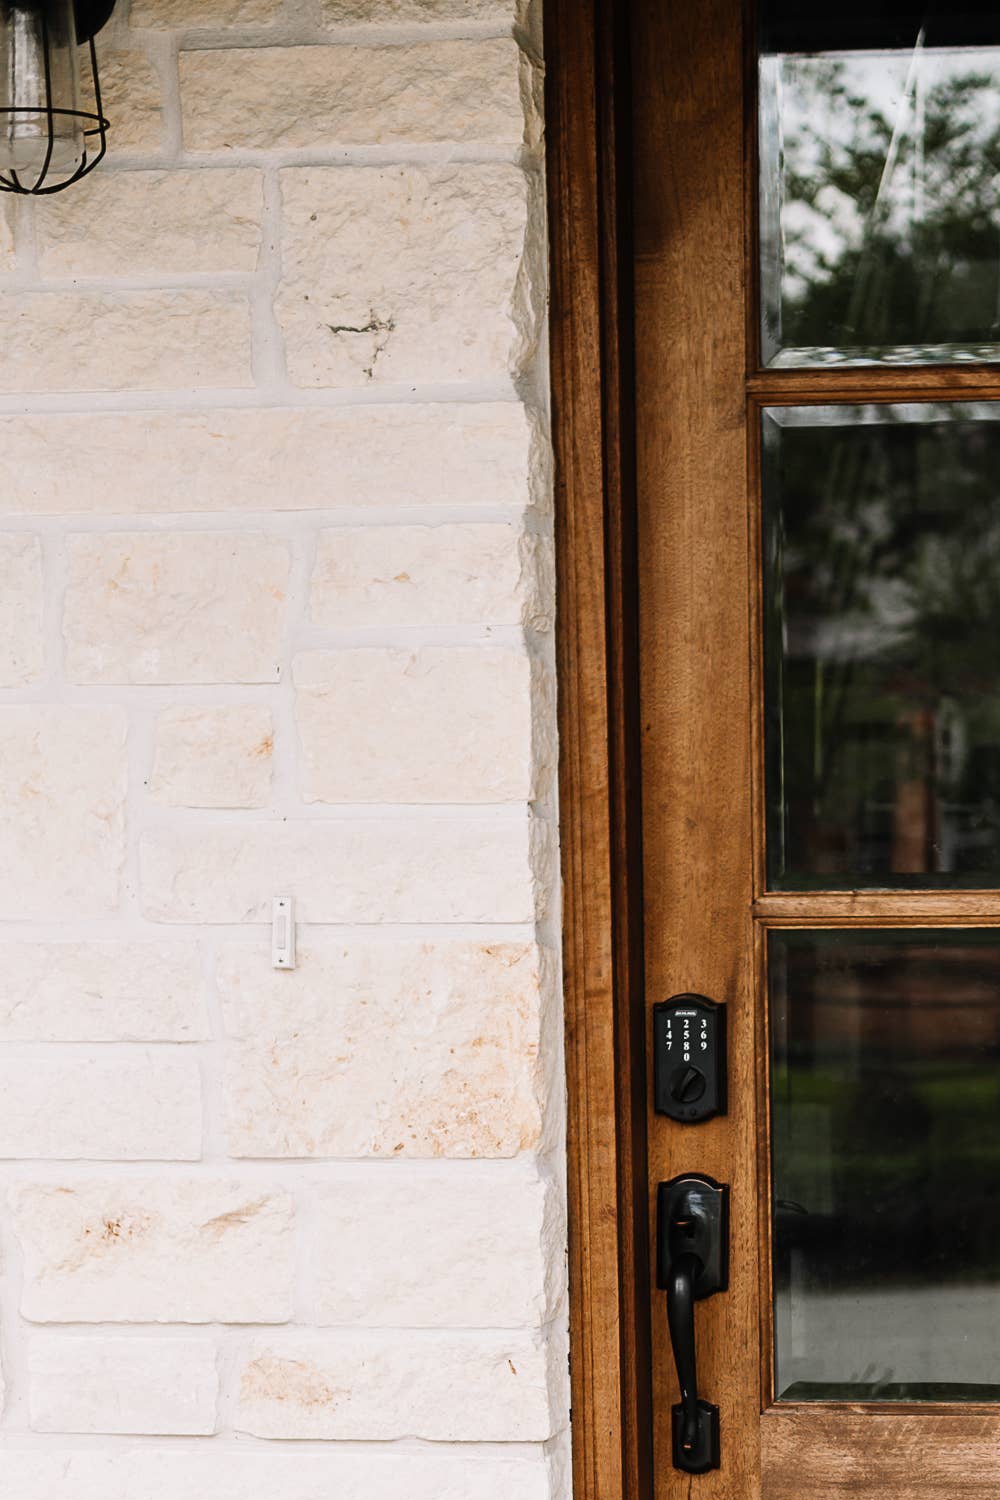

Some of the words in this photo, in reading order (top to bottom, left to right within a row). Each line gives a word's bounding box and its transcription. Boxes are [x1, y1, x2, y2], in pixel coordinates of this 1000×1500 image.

[667, 1019, 671, 1029] 1
[683, 1019, 690, 1029] 2
[700, 1019, 707, 1029] 3
[665, 1030, 672, 1040] 4
[683, 1030, 690, 1040] 5
[700, 1030, 707, 1040] 6
[666, 1041, 672, 1051] 7
[683, 1041, 690, 1051] 8
[700, 1041, 708, 1051] 9
[683, 1052, 690, 1062] 0
